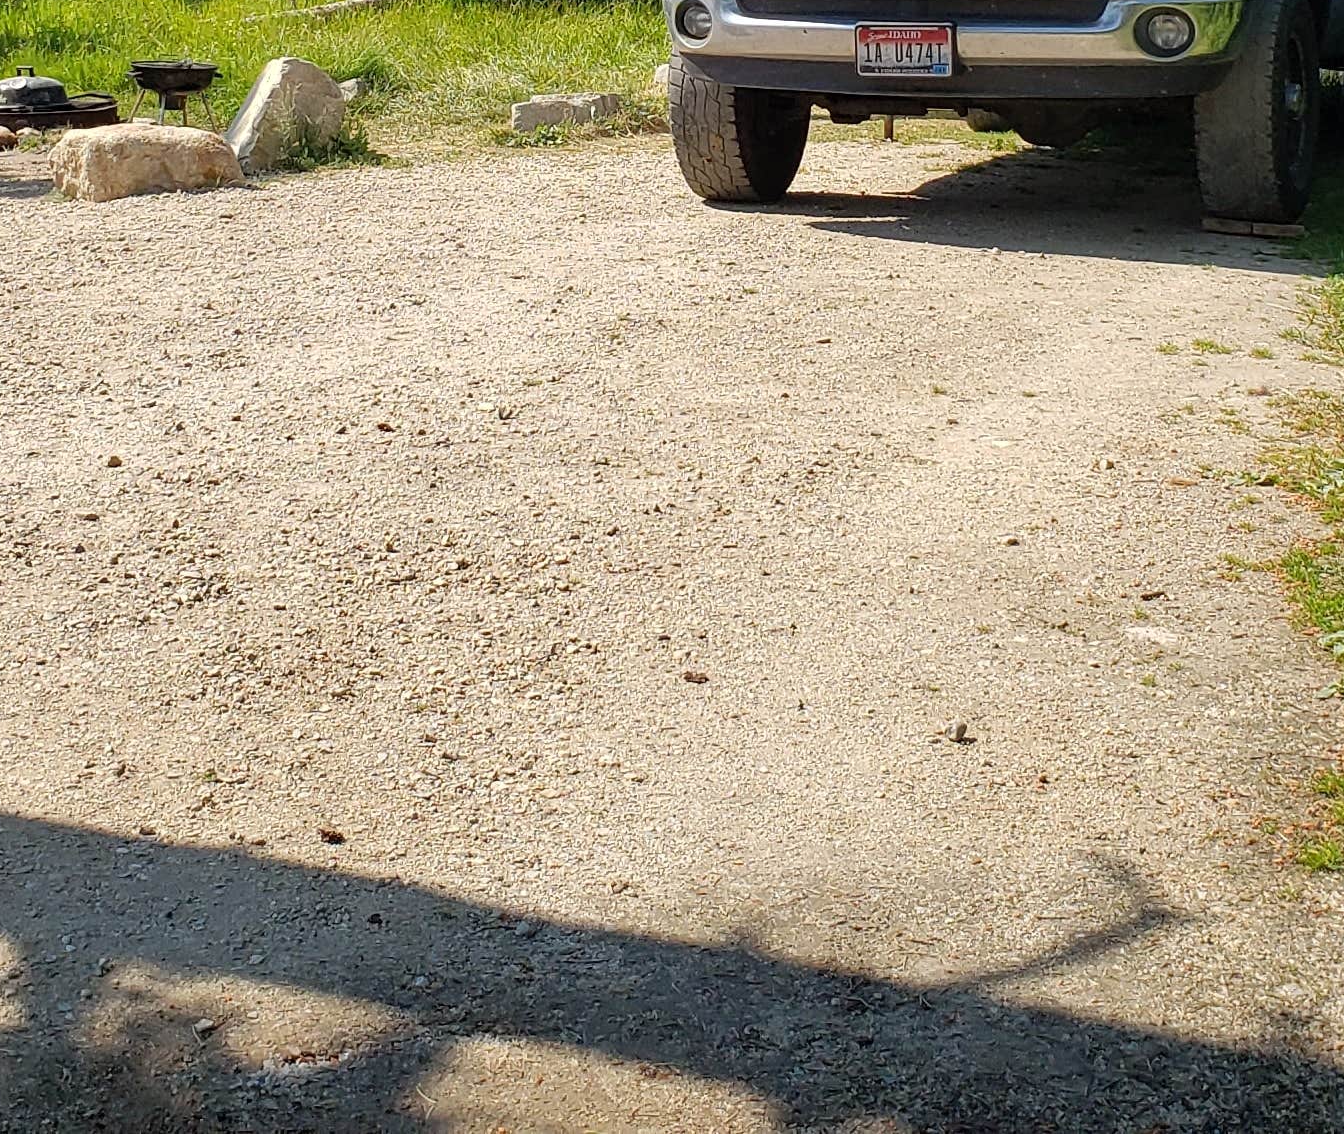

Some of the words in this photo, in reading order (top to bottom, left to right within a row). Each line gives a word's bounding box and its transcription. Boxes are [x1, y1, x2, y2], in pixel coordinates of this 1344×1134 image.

[888, 30, 922, 39] IDAHO
[864, 42, 882, 63] 1A
[895, 42, 944, 63] U474T
